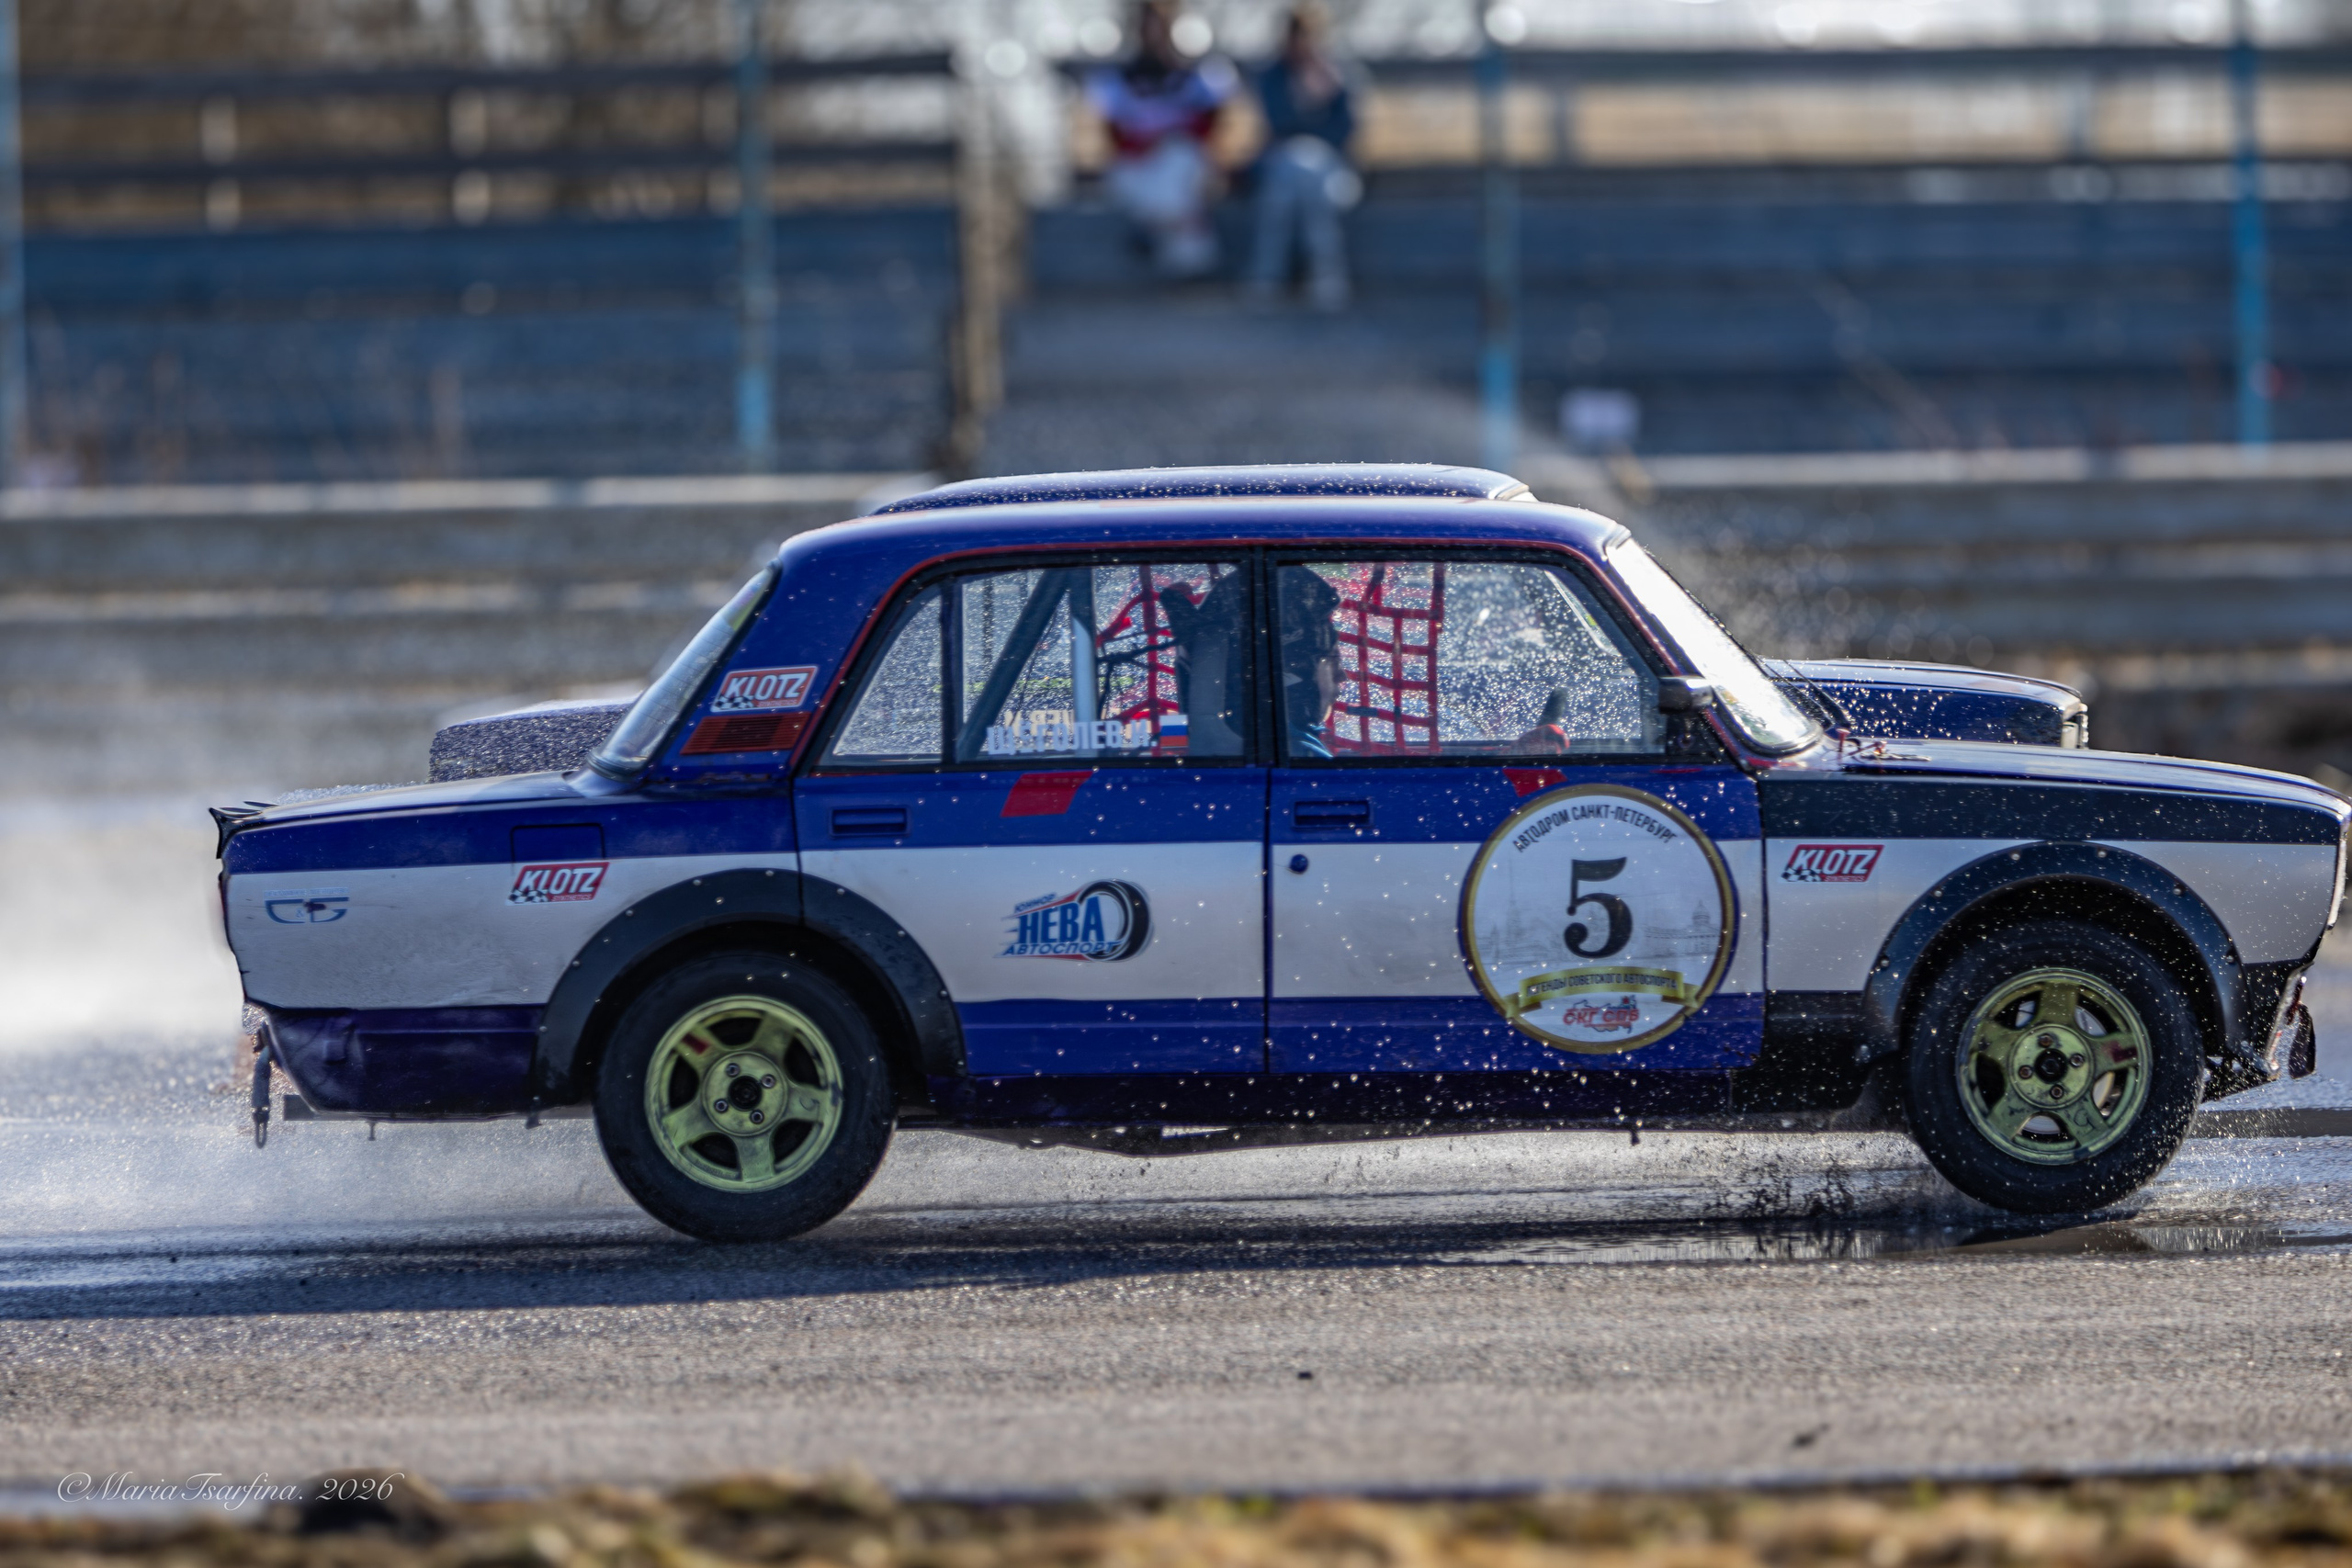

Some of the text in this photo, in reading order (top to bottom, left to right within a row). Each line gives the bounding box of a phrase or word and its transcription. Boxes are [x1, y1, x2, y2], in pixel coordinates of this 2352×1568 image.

[726, 672, 809, 701] KLOTZ
[1512, 804, 1679, 852] АВТОДРОМ САНКТ-ПЕТЕРБУРГ
[1792, 849, 1878, 874] KLOTZ
[518, 867, 604, 895] KLOTZ
[1019, 896, 1105, 944] НЕВА
[1563, 856, 1633, 959] 5
[1002, 941, 1121, 956] АВТОСПОРТ
